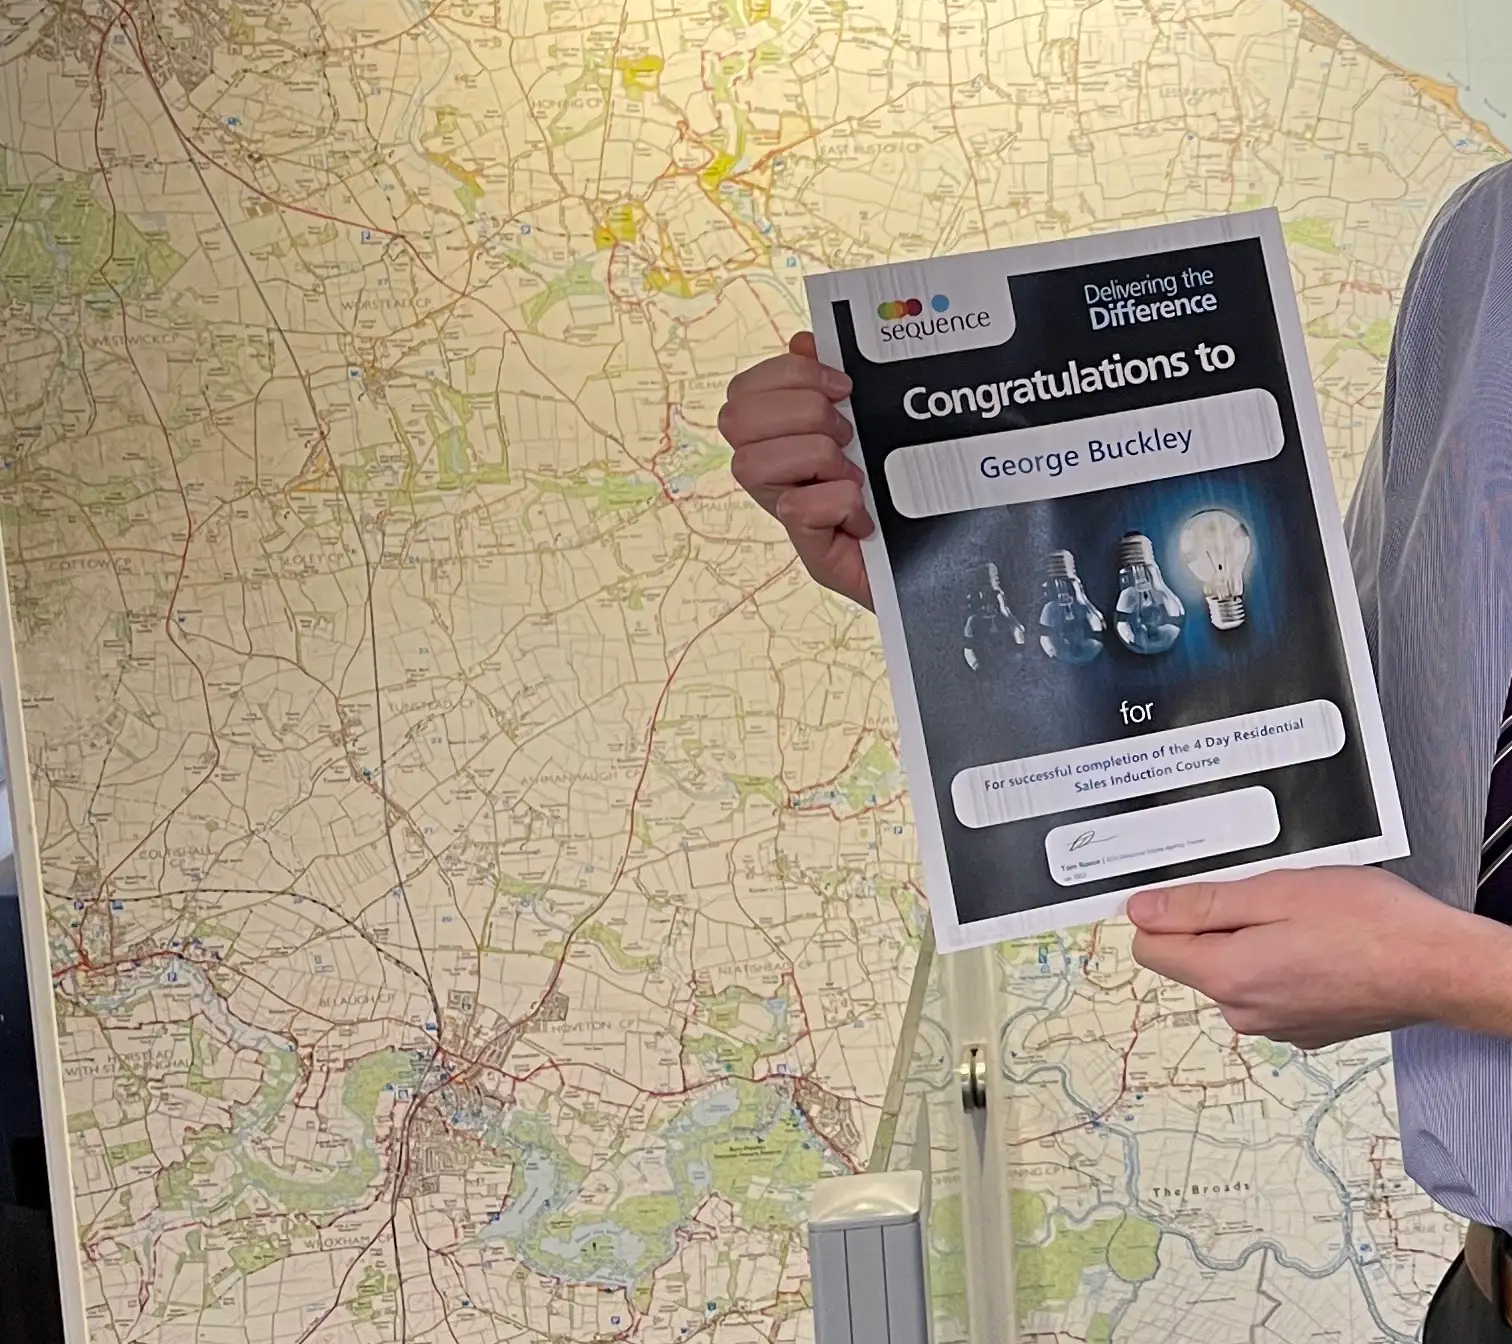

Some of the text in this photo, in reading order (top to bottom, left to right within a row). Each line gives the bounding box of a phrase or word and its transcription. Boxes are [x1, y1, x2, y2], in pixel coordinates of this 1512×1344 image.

[1084, 267, 1214, 305] Delivering the
[1089, 291, 1218, 331] Difference
[902, 341, 1236, 420] Congratulations to
[980, 427, 1192, 479] George Buckley
[1118, 700, 1154, 725] for
[984, 717, 1305, 793] For successful completion of the 4 Day Residential
[1074, 754, 1221, 794] Sales Induction Course
[551, 1021, 611, 1034] HOVETON
[1152, 1181, 1251, 1198] The Broads
